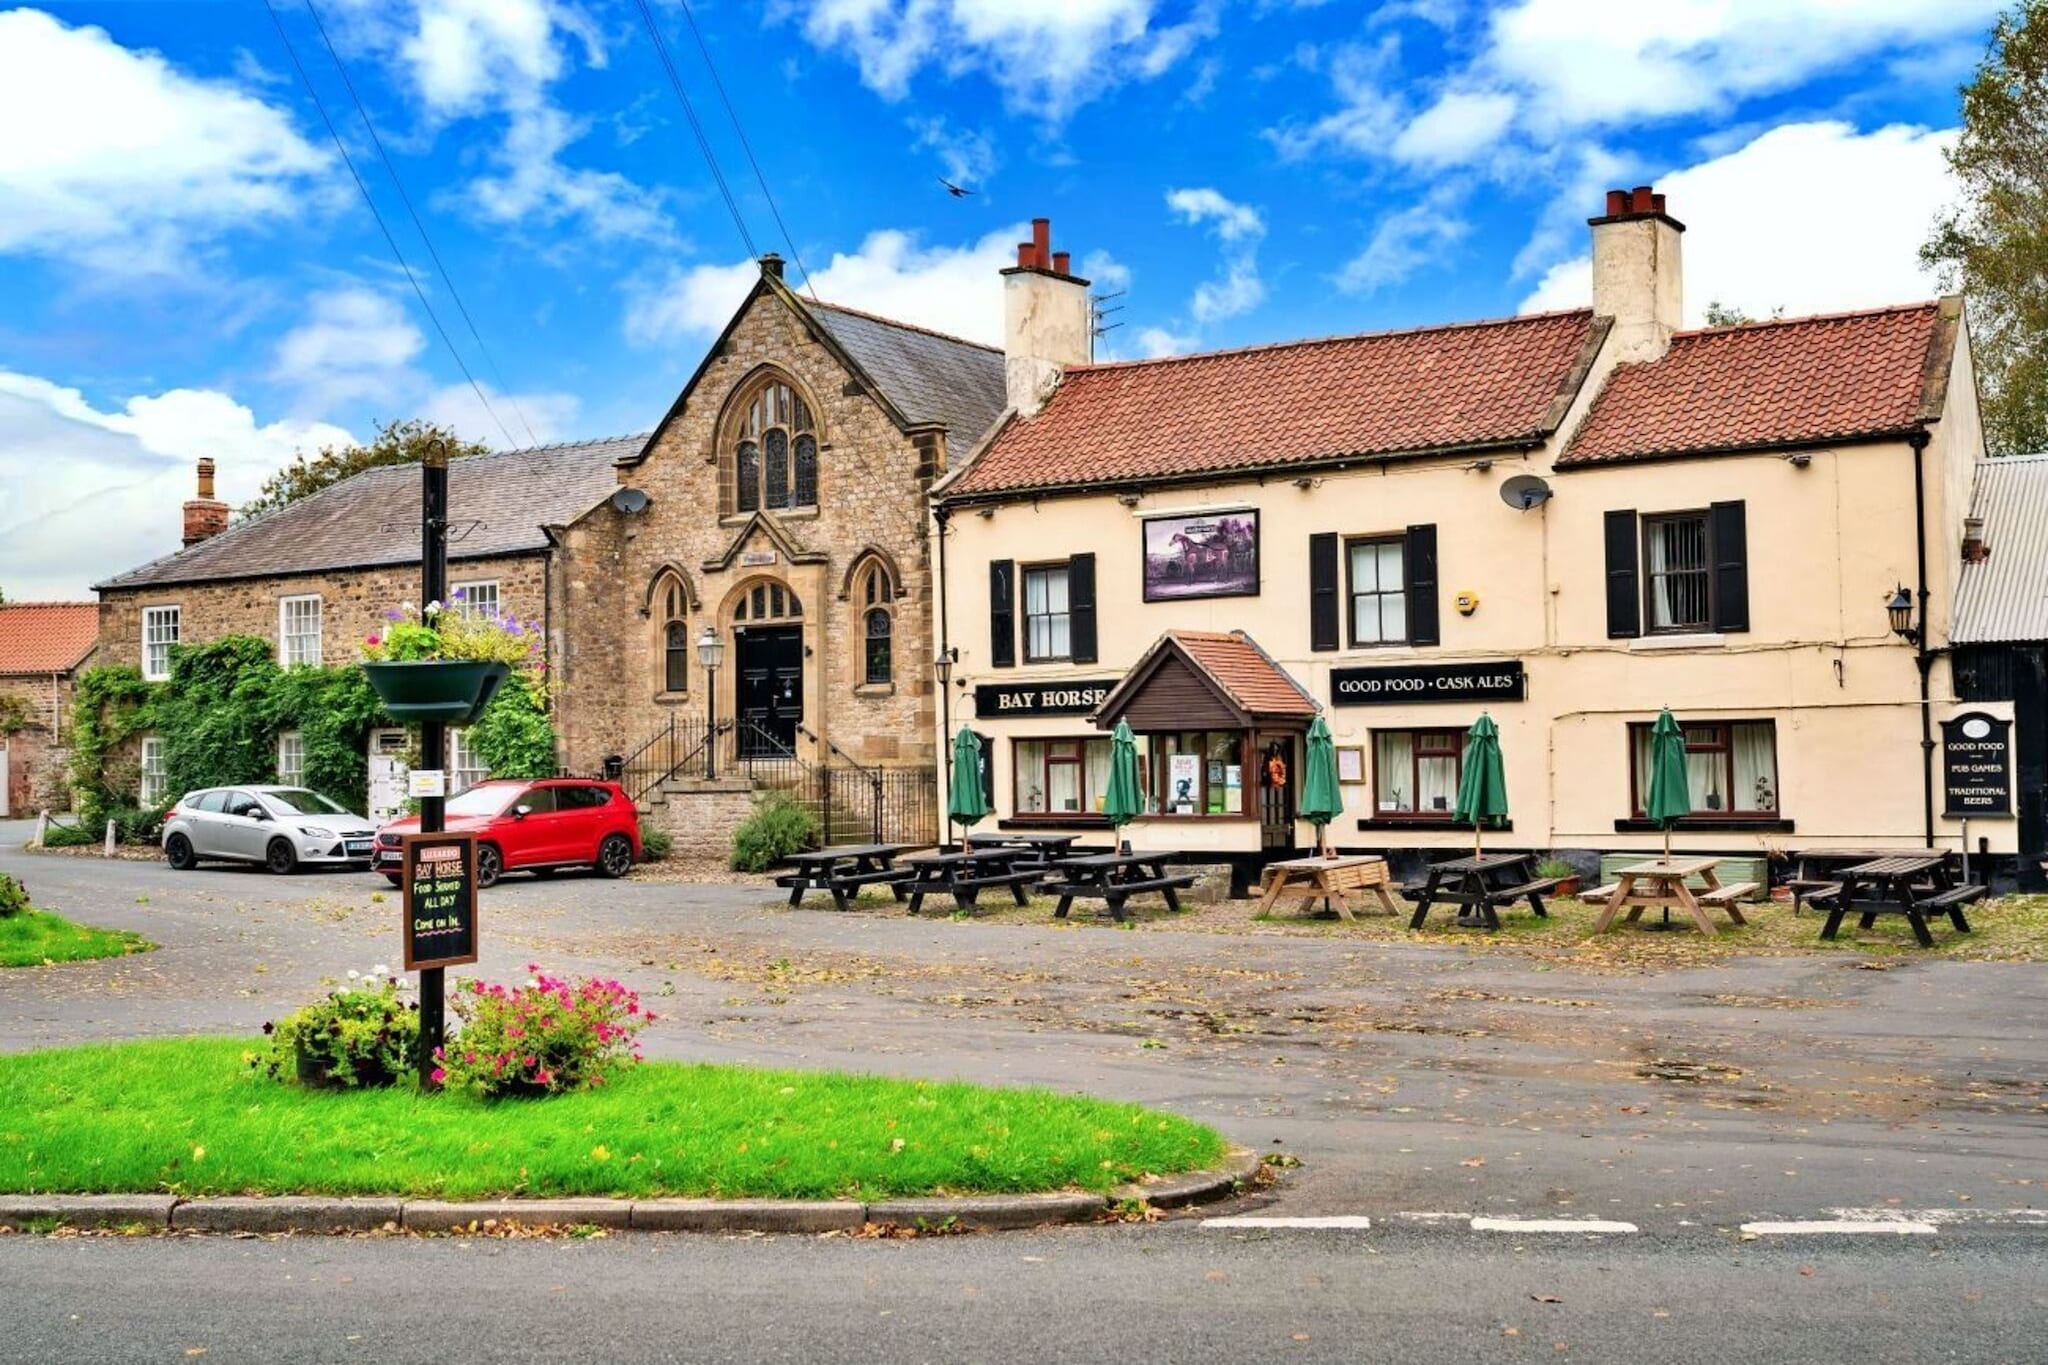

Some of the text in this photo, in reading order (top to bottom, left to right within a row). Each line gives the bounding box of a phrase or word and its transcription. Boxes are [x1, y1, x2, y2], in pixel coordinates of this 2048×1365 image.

[1339, 675, 1514, 693] GOOD FOOD CASK ALES
[998, 692, 1035, 709] BAY
[1948, 742, 2004, 751] GOOD FOOD
[1951, 764, 2002, 773] PUB GAMES
[1948, 787, 2006, 796] TRADITIONAL
[1964, 796, 1993, 805] BEERS
[416, 861, 463, 876] BAY HORSE
[424, 895, 456, 908] ALL DAY
